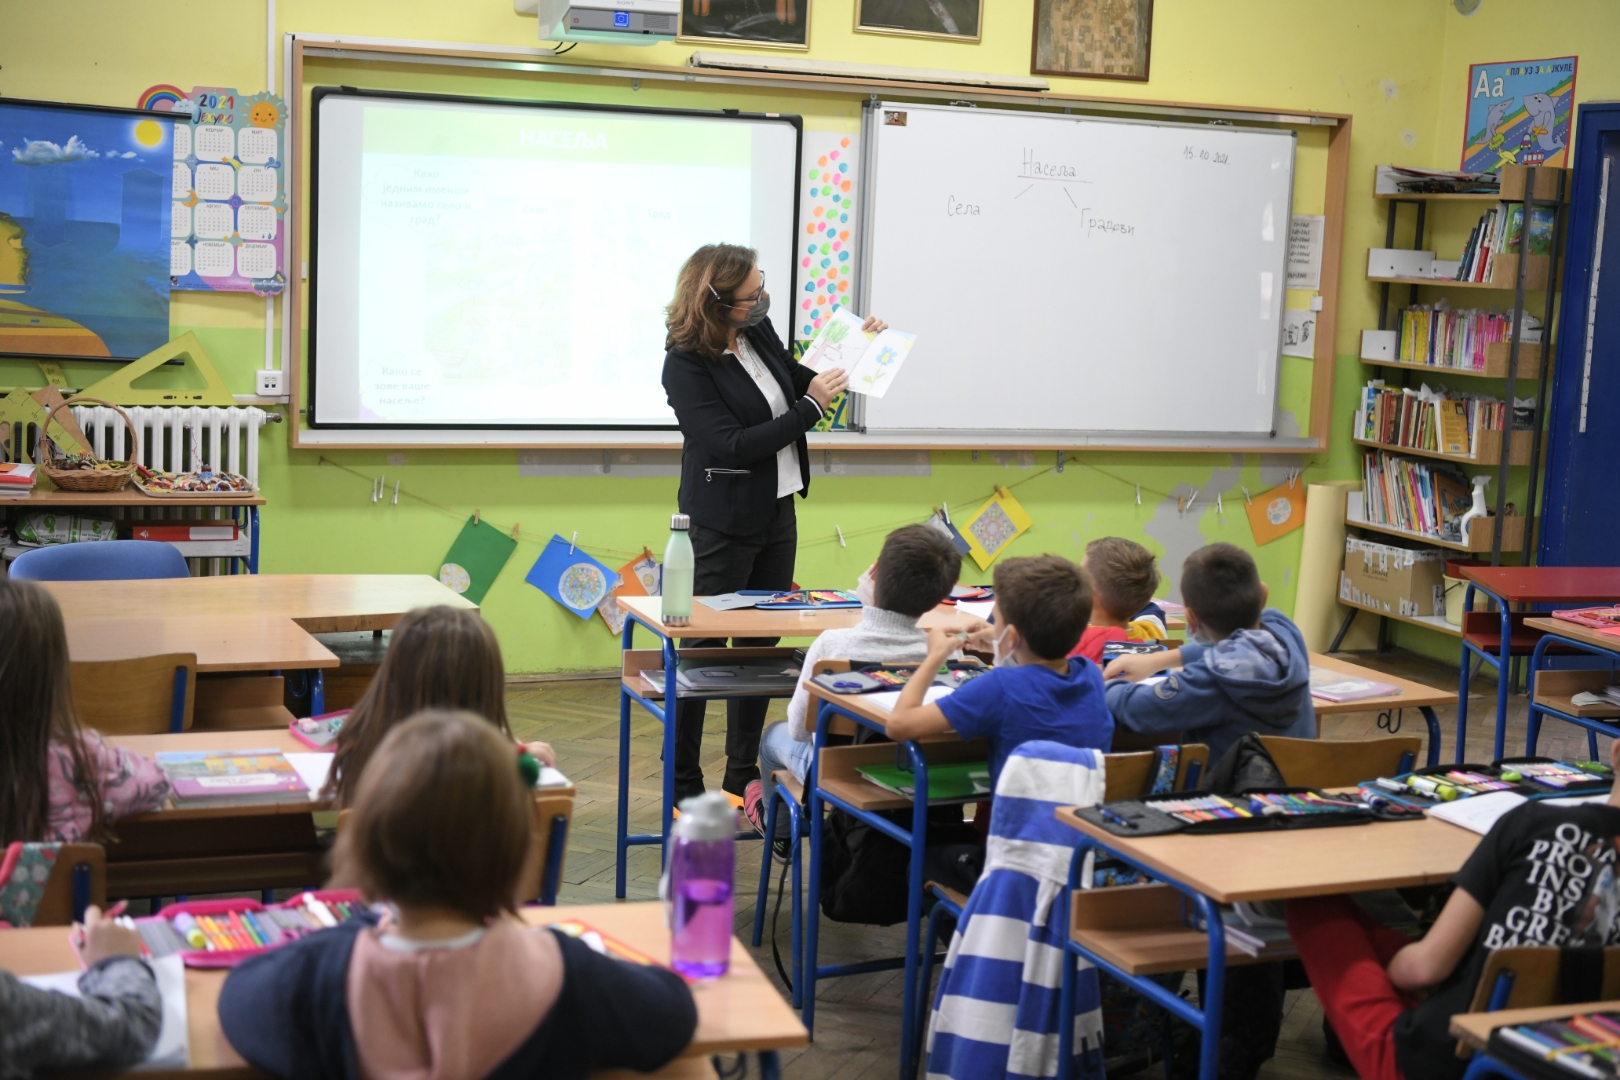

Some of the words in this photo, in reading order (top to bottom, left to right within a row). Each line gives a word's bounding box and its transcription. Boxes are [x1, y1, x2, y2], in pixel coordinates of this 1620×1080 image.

[1505, 66, 1533, 76] АПЛАУЗ
[1535, 65, 1544, 75] ЗА
[1546, 63, 1573, 74] АЈКУЛЕ
[199, 94, 235, 109] 2021
[519, 128, 609, 151] НАСЕЉА
[1022, 147, 1077, 177] Насеља
[413, 168, 440, 179] Како
[382, 182, 422, 195] једним
[425, 185, 470, 195] именом
[380, 200, 434, 209] називамо
[436, 201, 461, 210] село
[464, 202, 472, 210] и
[522, 204, 548, 215] Село
[947, 194, 981, 217] Села
[410, 214, 441, 226] град?
[647, 208, 671, 221] Град
[1081, 207, 1135, 238] Градови
[382, 367, 408, 376] Како
[410, 368, 422, 376] се
[374, 382, 399, 391] зове
[402, 382, 430, 391] ваше
[379, 396, 426, 405] насеље?
[1531, 886, 1576, 921] BY
